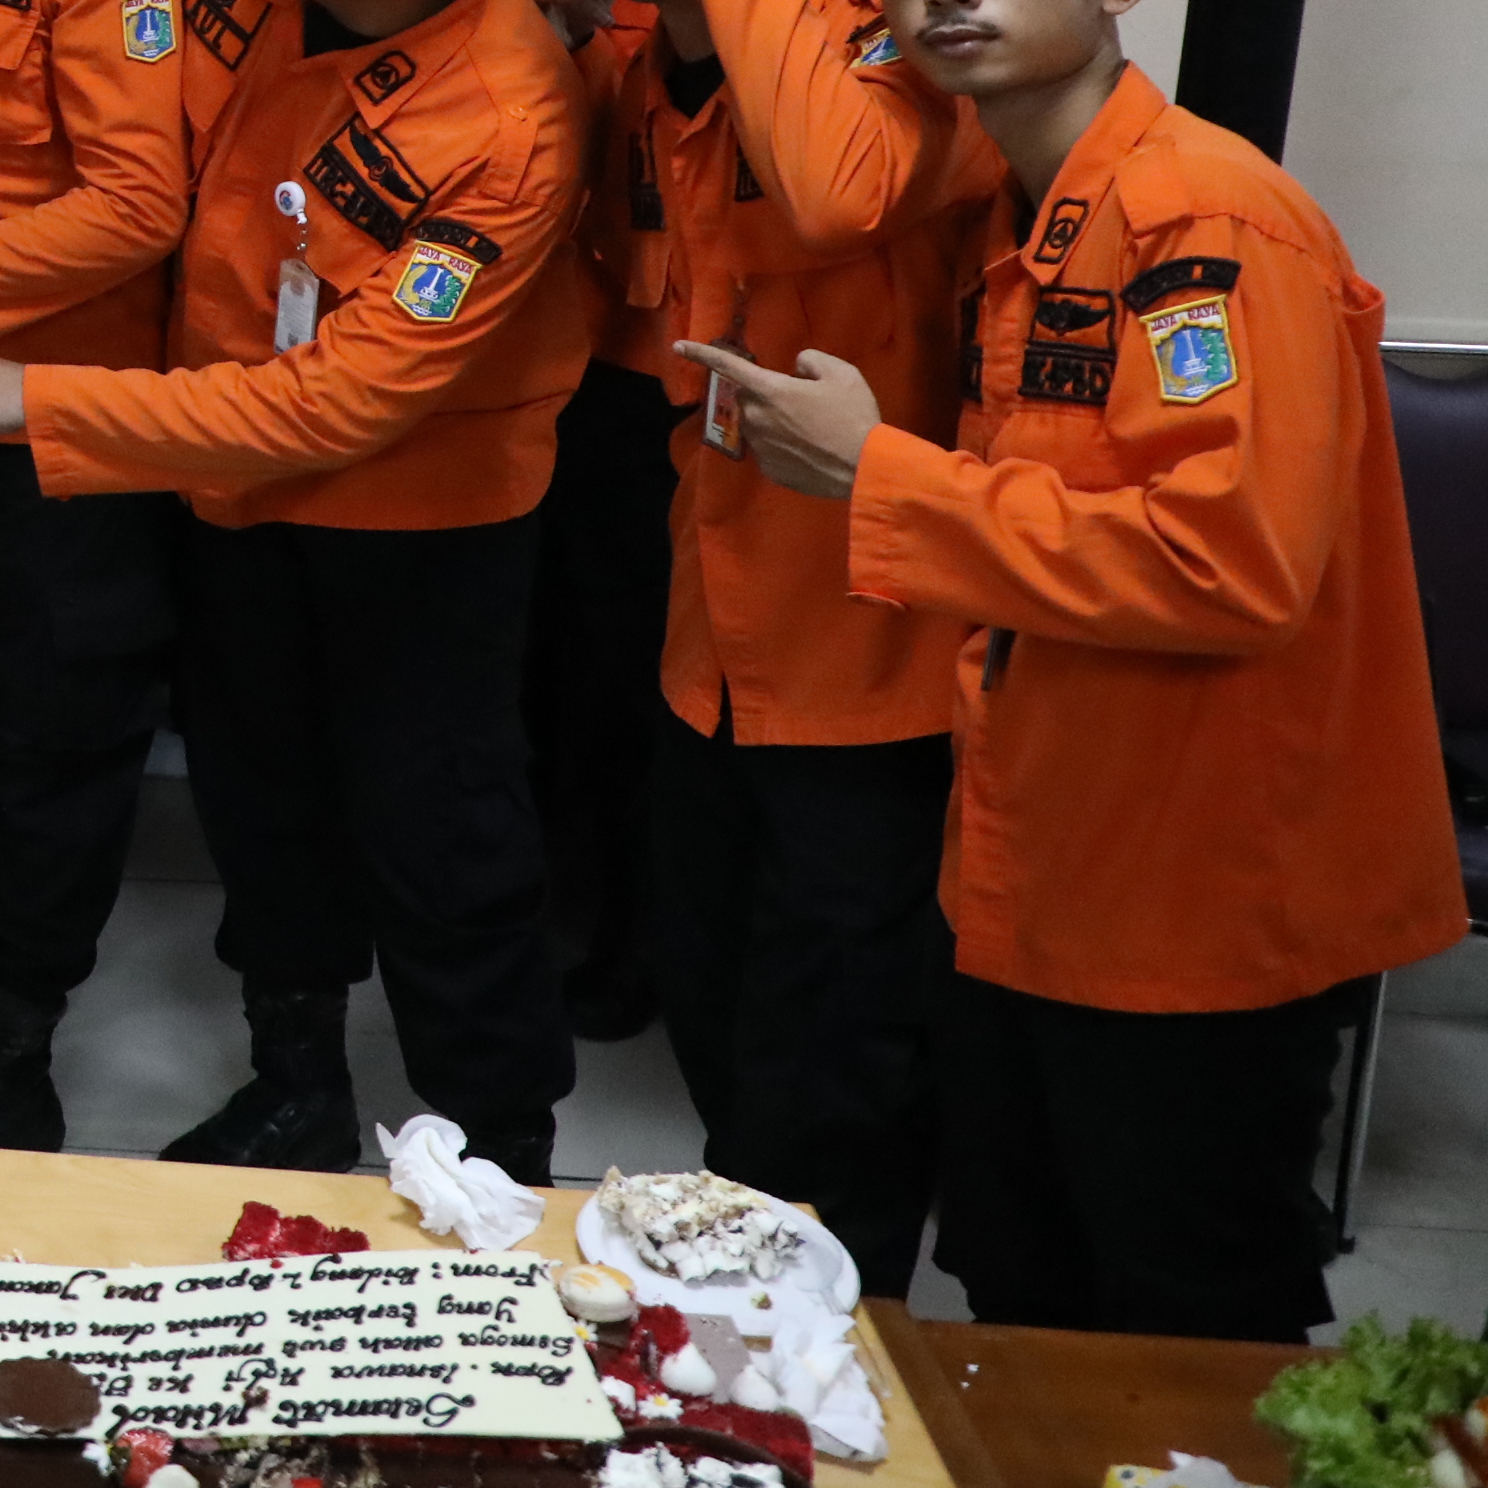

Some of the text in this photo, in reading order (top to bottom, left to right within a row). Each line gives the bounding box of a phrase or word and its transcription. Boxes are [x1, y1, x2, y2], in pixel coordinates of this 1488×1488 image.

[419, 245, 475, 274] JAYA RAYA
[1150, 304, 1220, 330] JAYA RAYA
[310, 1252, 420, 1293] Bidang
[165, 1310, 268, 1337] dunia
[287, 1301, 417, 1331] terbaik
[88, 1321, 156, 1344] dan
[458, 1324, 575, 1357] Semoga
[271, 1392, 477, 1428] Selamat
